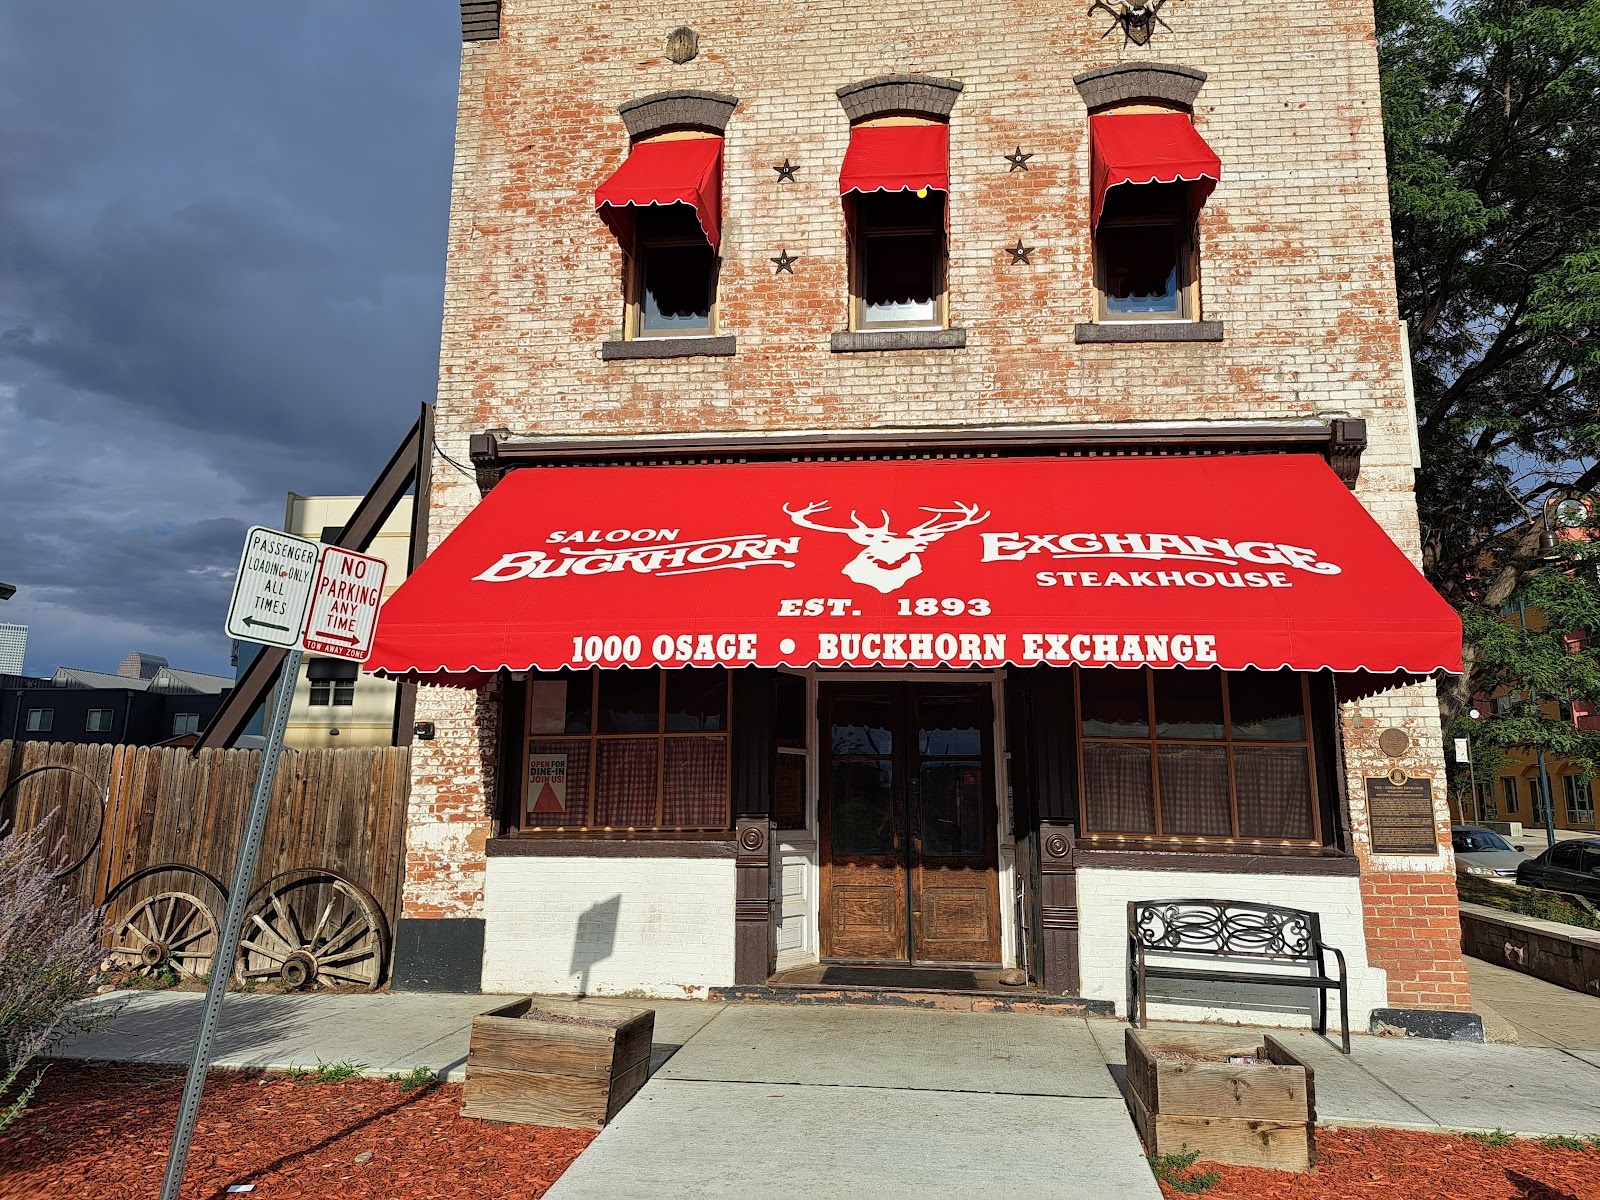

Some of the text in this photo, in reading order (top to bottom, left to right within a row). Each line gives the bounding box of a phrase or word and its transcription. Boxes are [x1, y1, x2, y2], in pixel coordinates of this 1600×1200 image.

[545, 529, 680, 544] SALOON
[253, 537, 314, 565] PASSENGER
[471, 537, 801, 582] BUCKHORN
[979, 532, 1342, 575] EXCHANGE
[248, 556, 310, 583] LOADING ONLY
[341, 557, 366, 579] NO
[264, 580, 284, 596] ALL
[1035, 571, 1293, 587] STEAKHOUSE
[320, 577, 377, 607] PARKING
[255, 596, 287, 615] TIMES
[331, 600, 358, 616] ANY
[777, 598, 991, 616] EST. 1893
[327, 614, 357, 632] TIME
[307, 641, 365, 659] TOW AWAY ZONE
[572, 633, 1217, 662] 1000 OSAGE BUCKHORN EXCHANGE
[530, 768, 565, 776] DINE-IN
